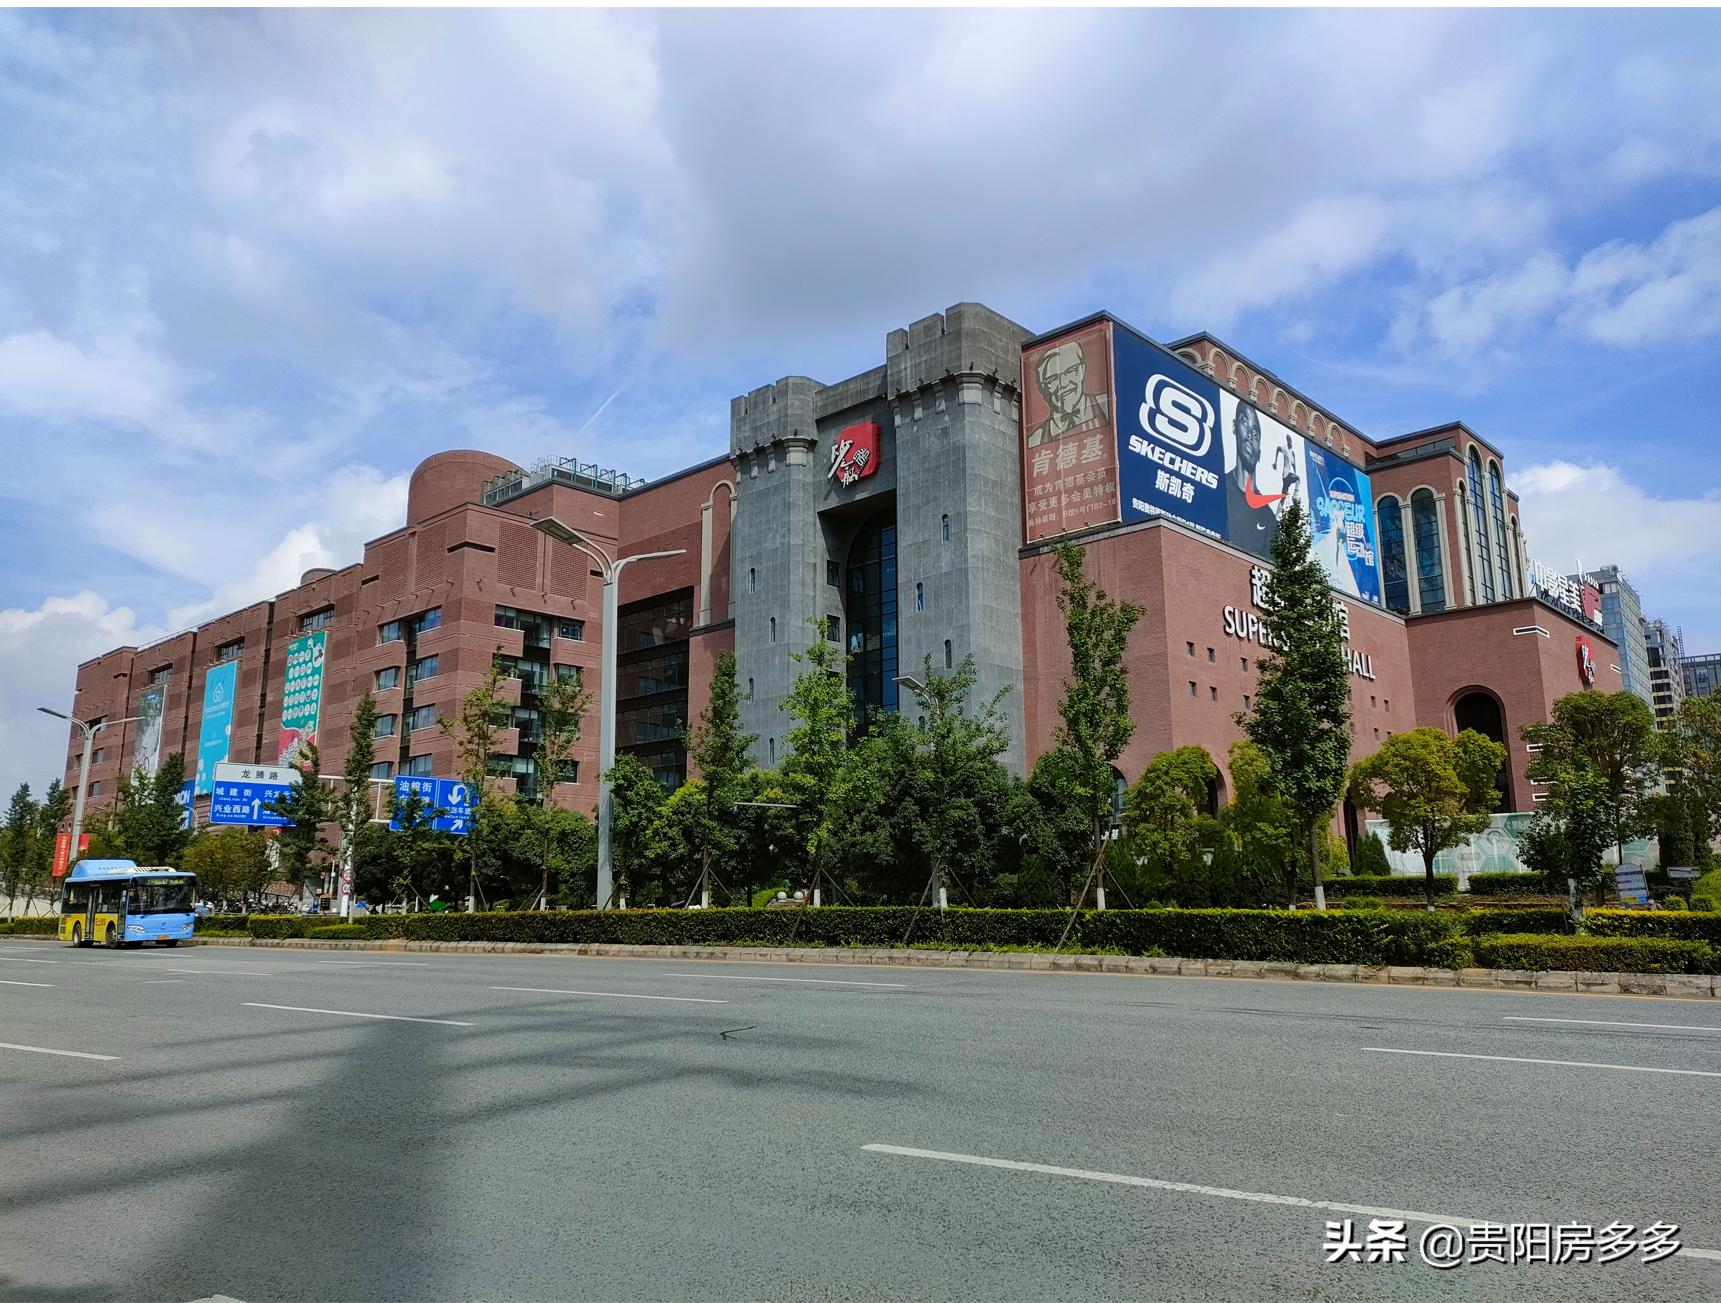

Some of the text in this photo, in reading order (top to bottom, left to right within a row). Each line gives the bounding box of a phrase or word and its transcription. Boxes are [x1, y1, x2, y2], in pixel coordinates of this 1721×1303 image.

[1032, 434, 1104, 478] 肯德基
[1128, 435, 1219, 489] SKECHERS
[1027, 481, 1115, 514] 享受更多会员特权
[1034, 467, 1106, 497] 成为肯德基会员
[1155, 469, 1195, 504] 斯凯奇
[241, 769, 278, 780] 龙腾路
[215, 787, 252, 797] 城建街
[214, 804, 250, 813] 兴业西路
